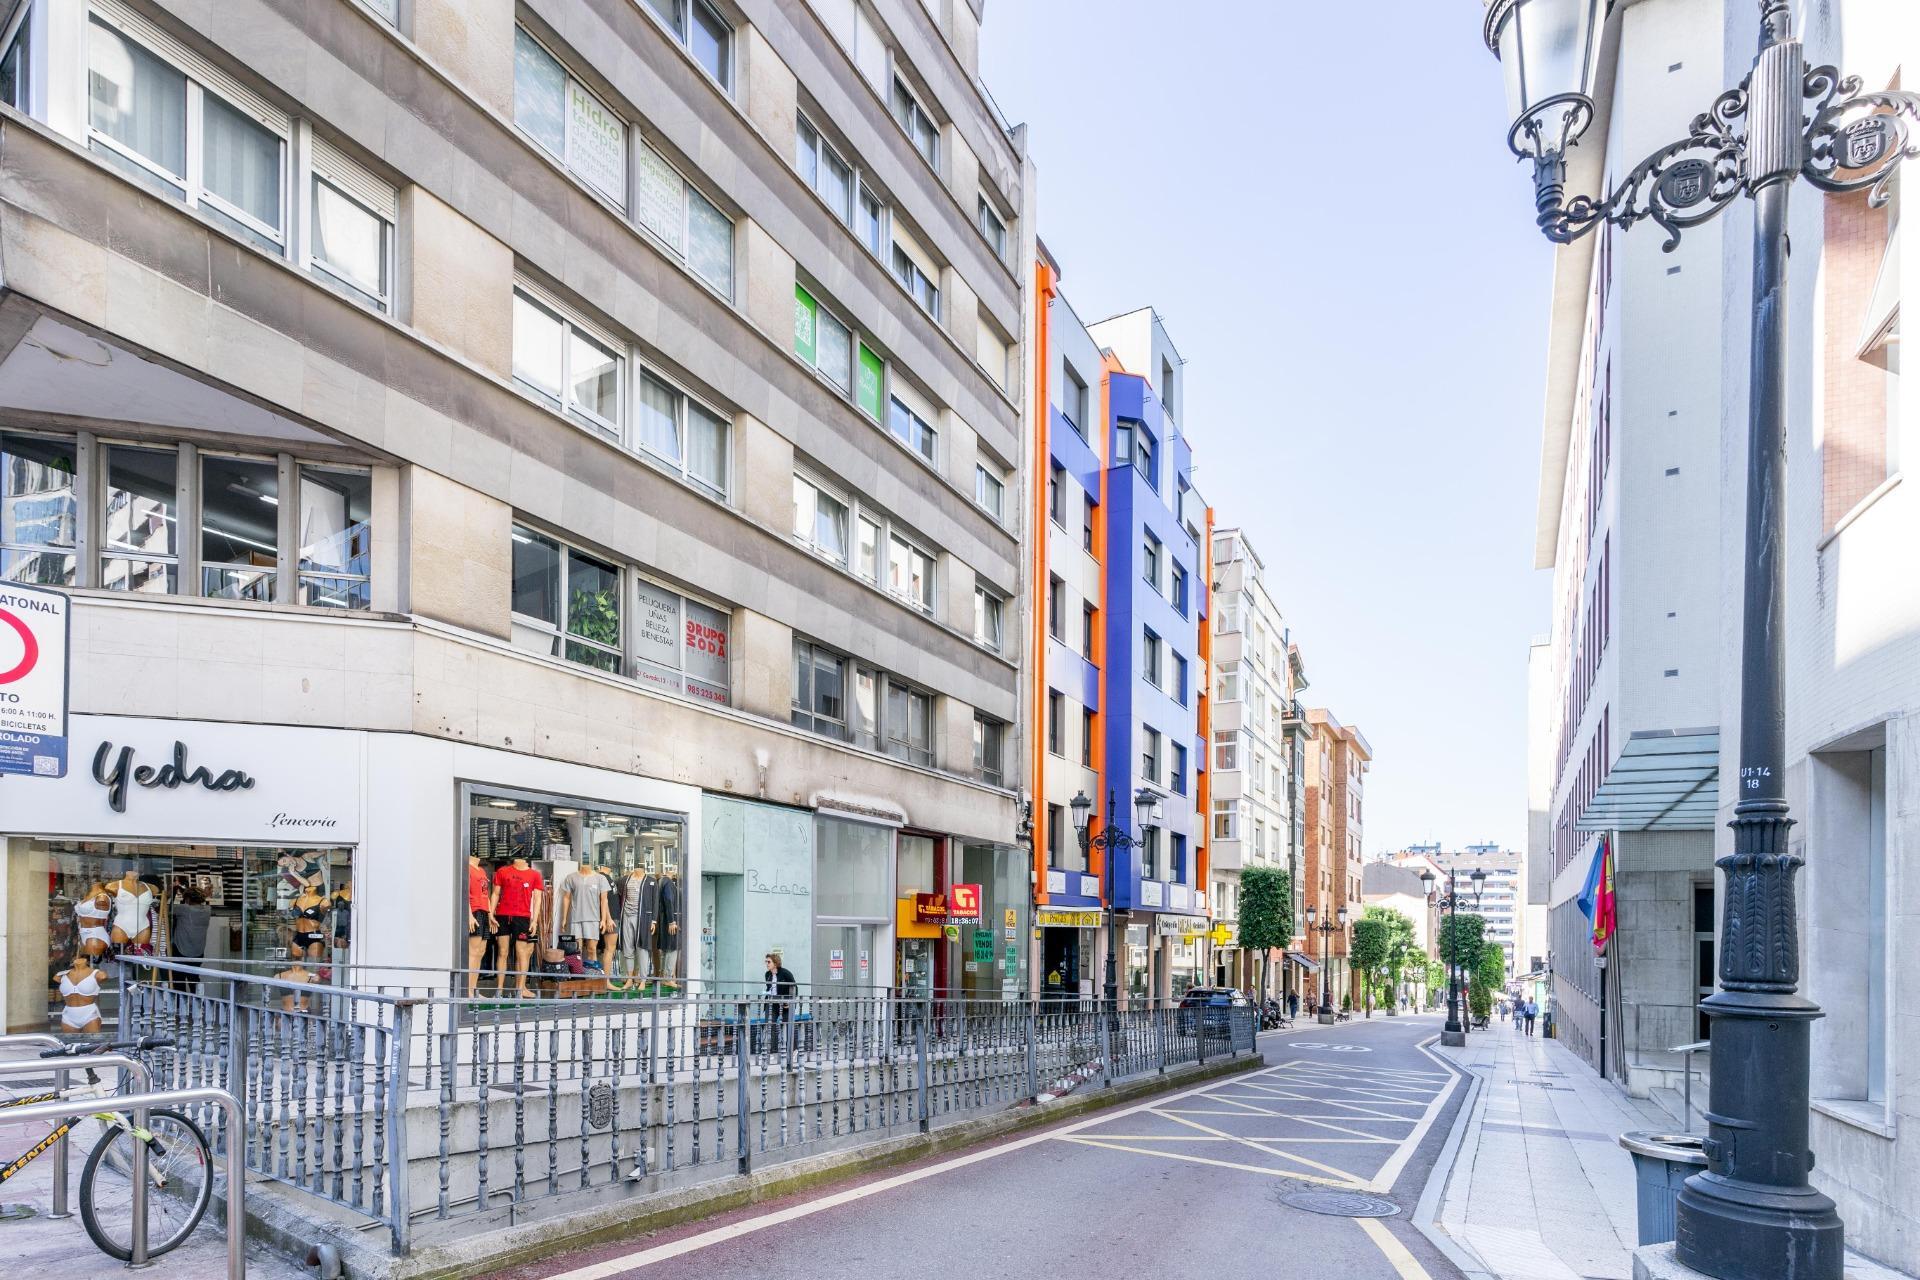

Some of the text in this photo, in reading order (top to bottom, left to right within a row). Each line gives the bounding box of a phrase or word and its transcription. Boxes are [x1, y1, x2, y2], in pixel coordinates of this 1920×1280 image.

[573, 88, 619, 141] Hidro
[0, 594, 60, 615] ATONAL
[648, 609, 667, 623] UÑAS
[645, 620, 670, 635] BELLEZA
[686, 620, 726, 645] GRUPO
[641, 629, 674, 647] BIENESTAR
[686, 633, 726, 657] MODA
[0, 692, 20, 703] TO
[687, 684, 726, 703] 985 225 345
[26, 711, 46, 719] 11:00
[1, 720, 47, 731] BICICLETAS
[92, 740, 256, 814] Yedra
[1746, 779, 1760, 789] 18
[264, 812, 337, 829] Lencería
[975, 940, 993, 949] VENDE
